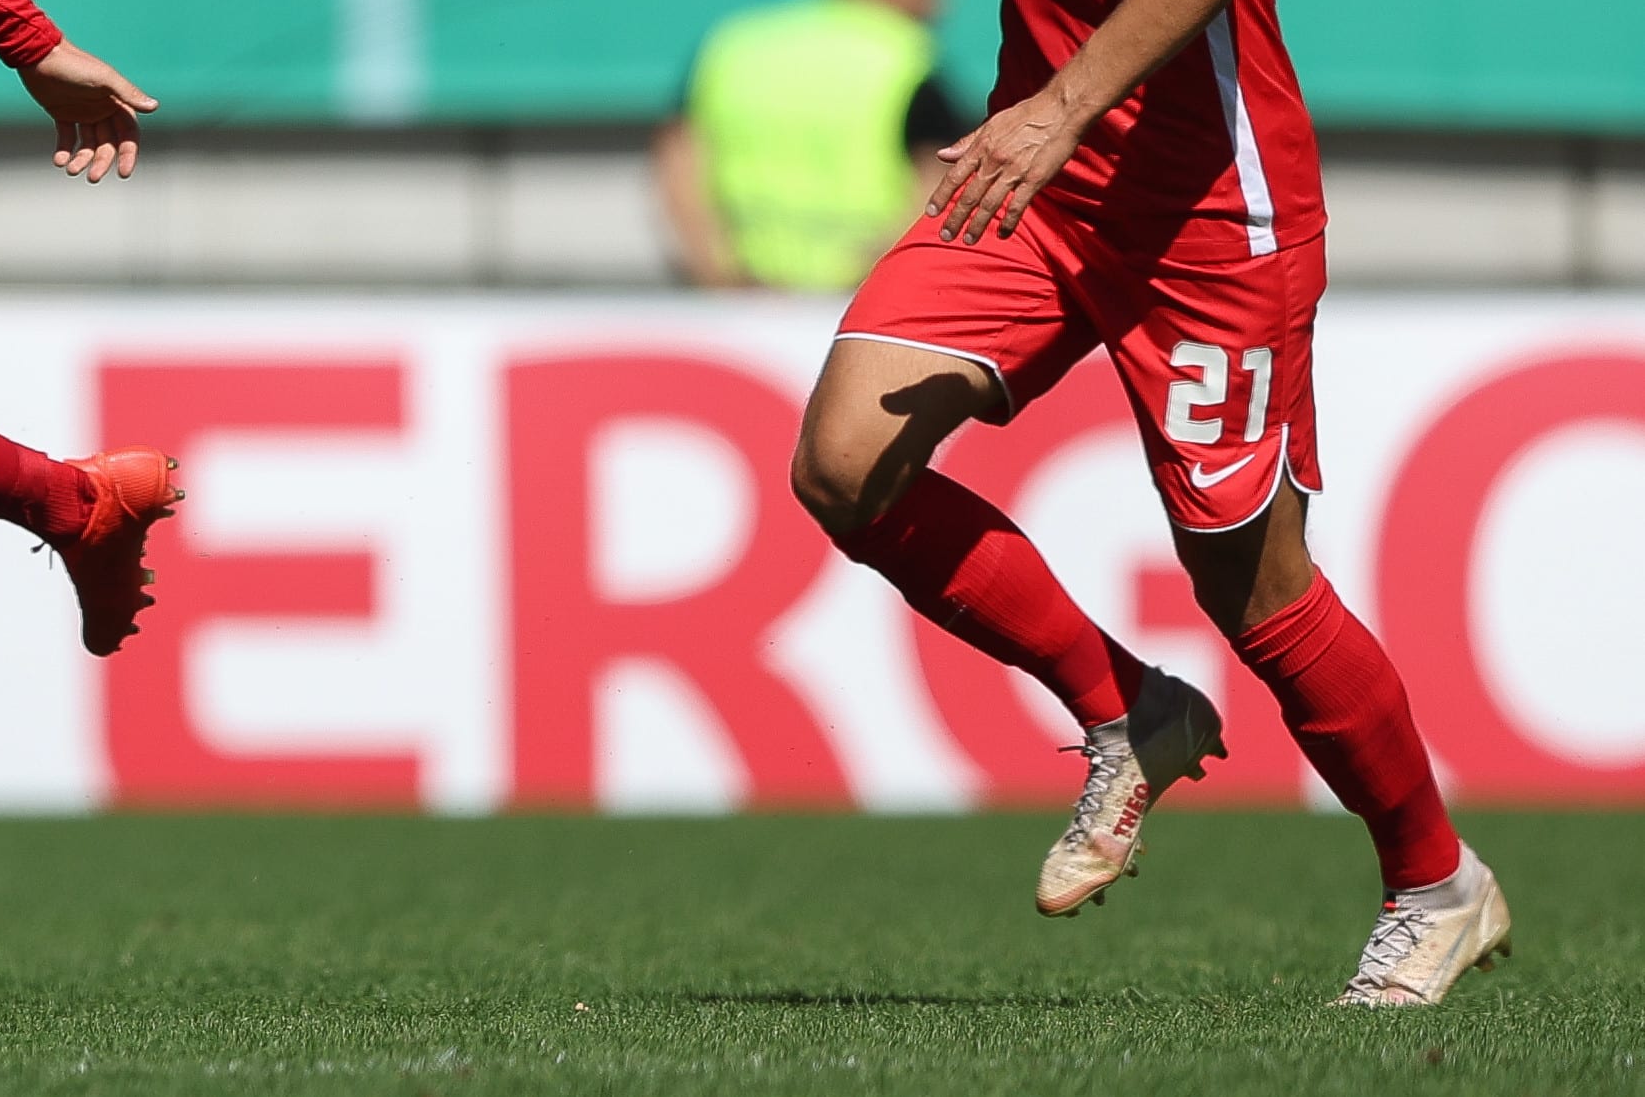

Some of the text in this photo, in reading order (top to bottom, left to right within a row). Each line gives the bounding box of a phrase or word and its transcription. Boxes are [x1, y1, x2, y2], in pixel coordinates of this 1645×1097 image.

[1163, 339, 1273, 445] 21
[97, 346, 1645, 815] ERGO
[1113, 783, 1151, 838] THEO
